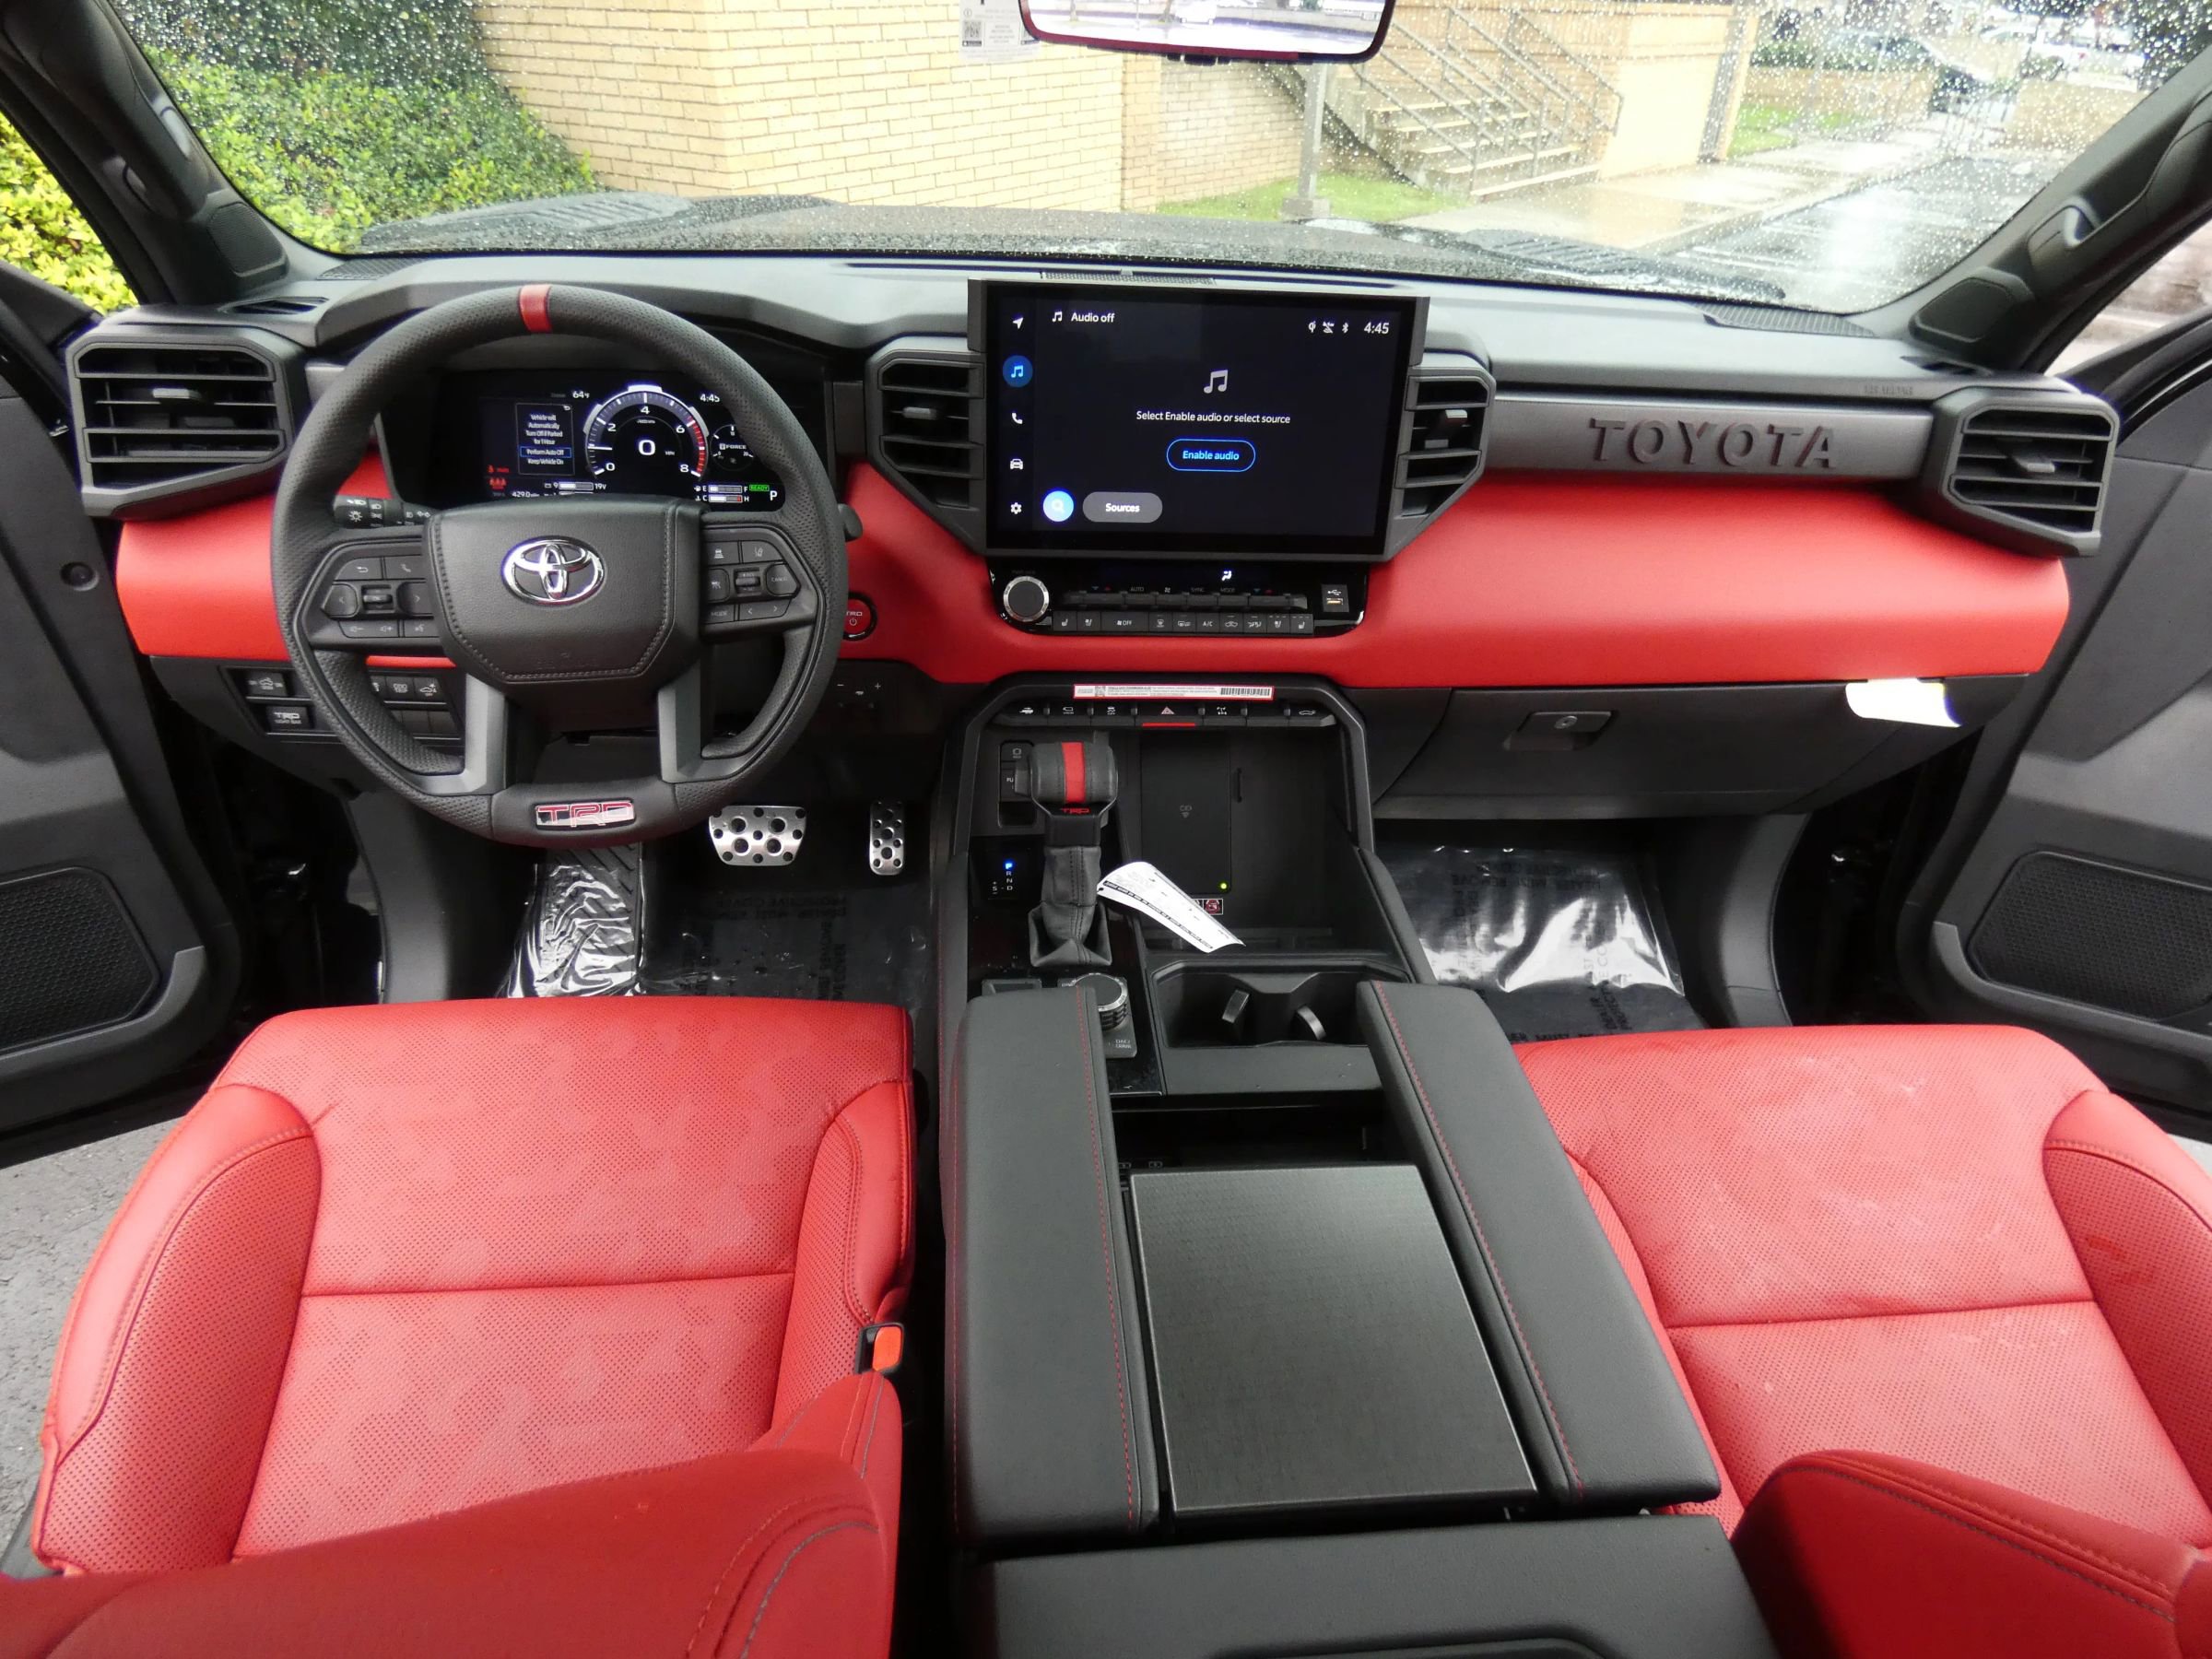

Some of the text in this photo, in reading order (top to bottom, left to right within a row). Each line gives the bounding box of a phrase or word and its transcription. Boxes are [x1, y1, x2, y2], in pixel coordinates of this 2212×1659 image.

[1071, 312, 1115, 323] Audio off
[1363, 322, 1390, 334] 4:45
[700, 394, 721, 403] 4:45
[641, 406, 650, 415] 4
[1136, 410, 1163, 420] Select
[1165, 411, 1195, 421] Enable
[1196, 412, 1222, 422] audio
[1234, 414, 1260, 423] select
[1262, 415, 1290, 424] source
[607, 424, 617, 432] 2
[676, 425, 686, 433] 6
[638, 440, 656, 456] 0
[1588, 417, 1837, 470] TOYOTA
[1182, 450, 1240, 460] Enable audio
[606, 463, 616, 471] 0
[679, 465, 688, 473] 8
[770, 490, 778, 501] P
[1105, 502, 1140, 513] Sources
